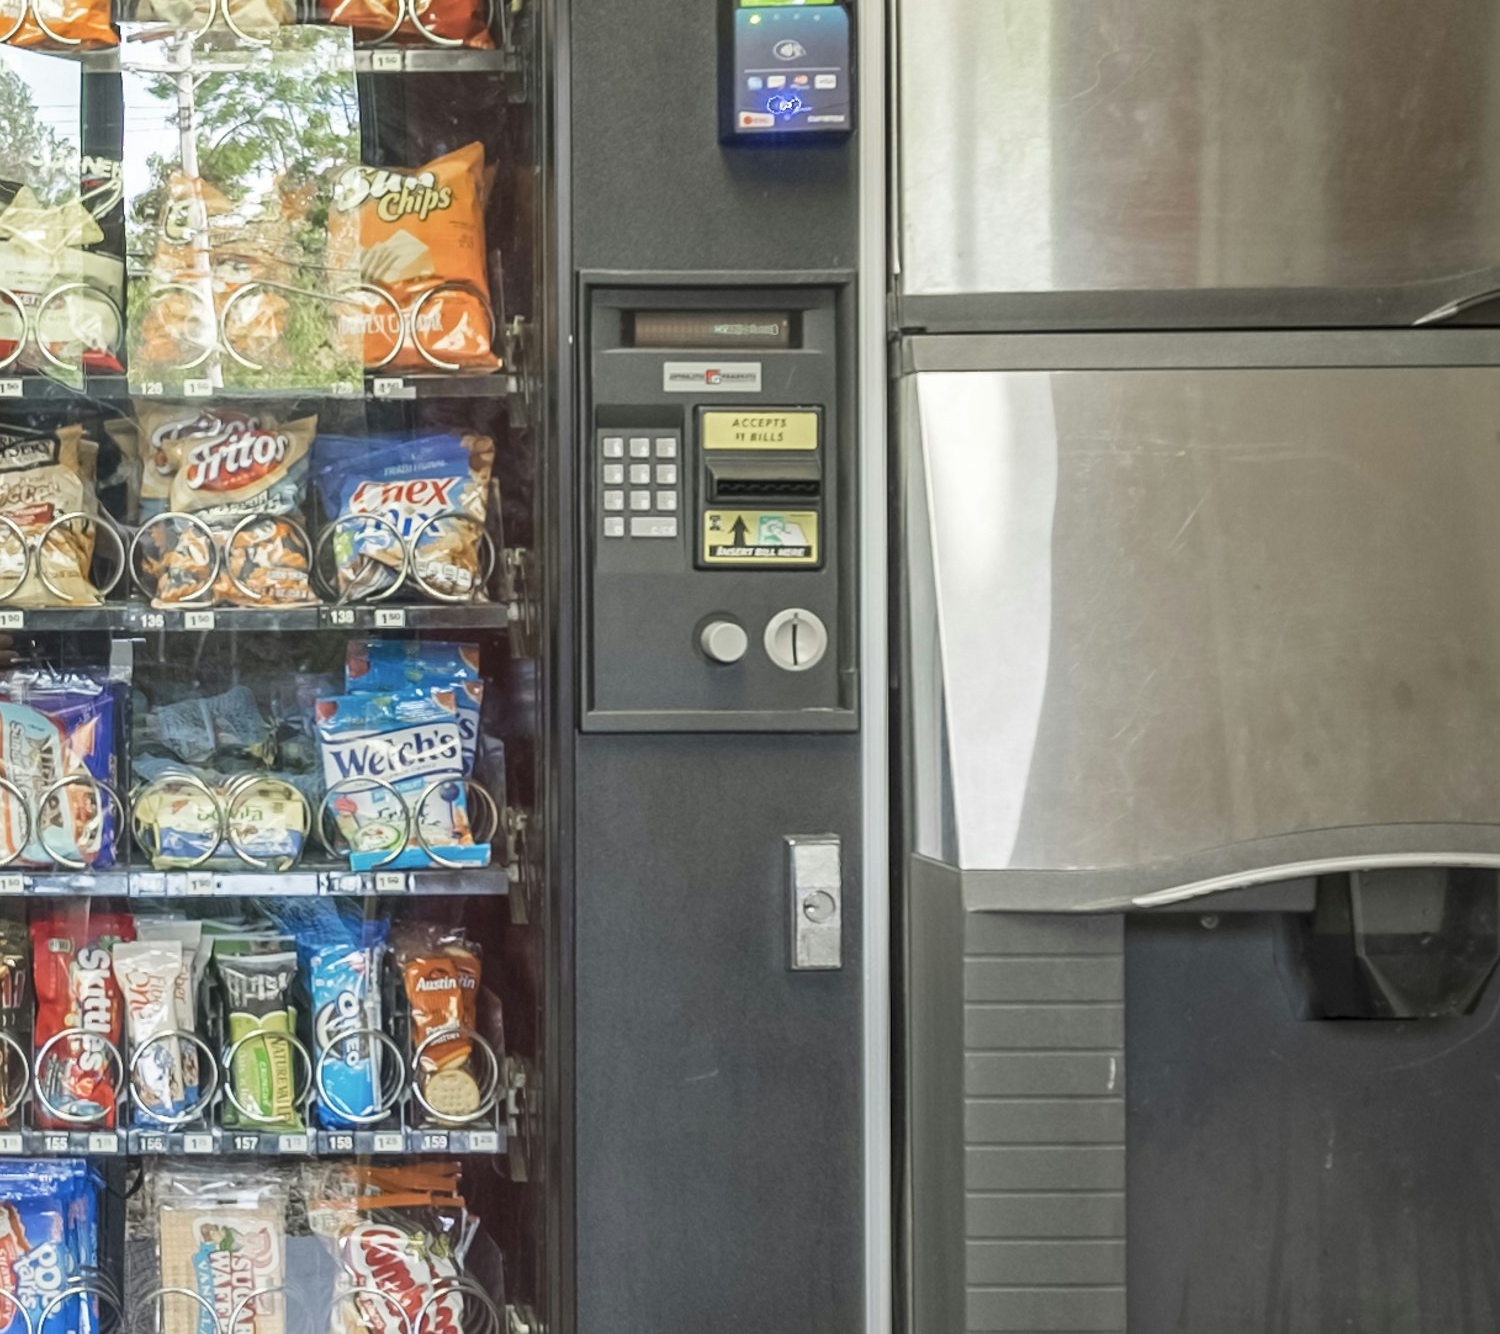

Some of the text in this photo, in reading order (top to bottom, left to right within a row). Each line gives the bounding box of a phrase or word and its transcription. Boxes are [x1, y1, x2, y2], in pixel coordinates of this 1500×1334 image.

[336, 167, 435, 211] Sun
[379, 185, 452, 222] Chips
[732, 418, 787, 428] ACCEPTS
[750, 432, 785, 442] BILLS
[186, 433, 289, 489] Fritos
[716, 546, 754, 557] INSERT
[755, 548, 777, 557] BILL
[416, 976, 456, 992] Austin
[77, 948, 112, 1071] Skittles
[336, 991, 360, 1066] OEO
[44, 1135, 68, 1151] 155
[140, 1135, 164, 1151] 156
[234, 1135, 259, 1151] 157
[425, 1135, 448, 1150] 159
